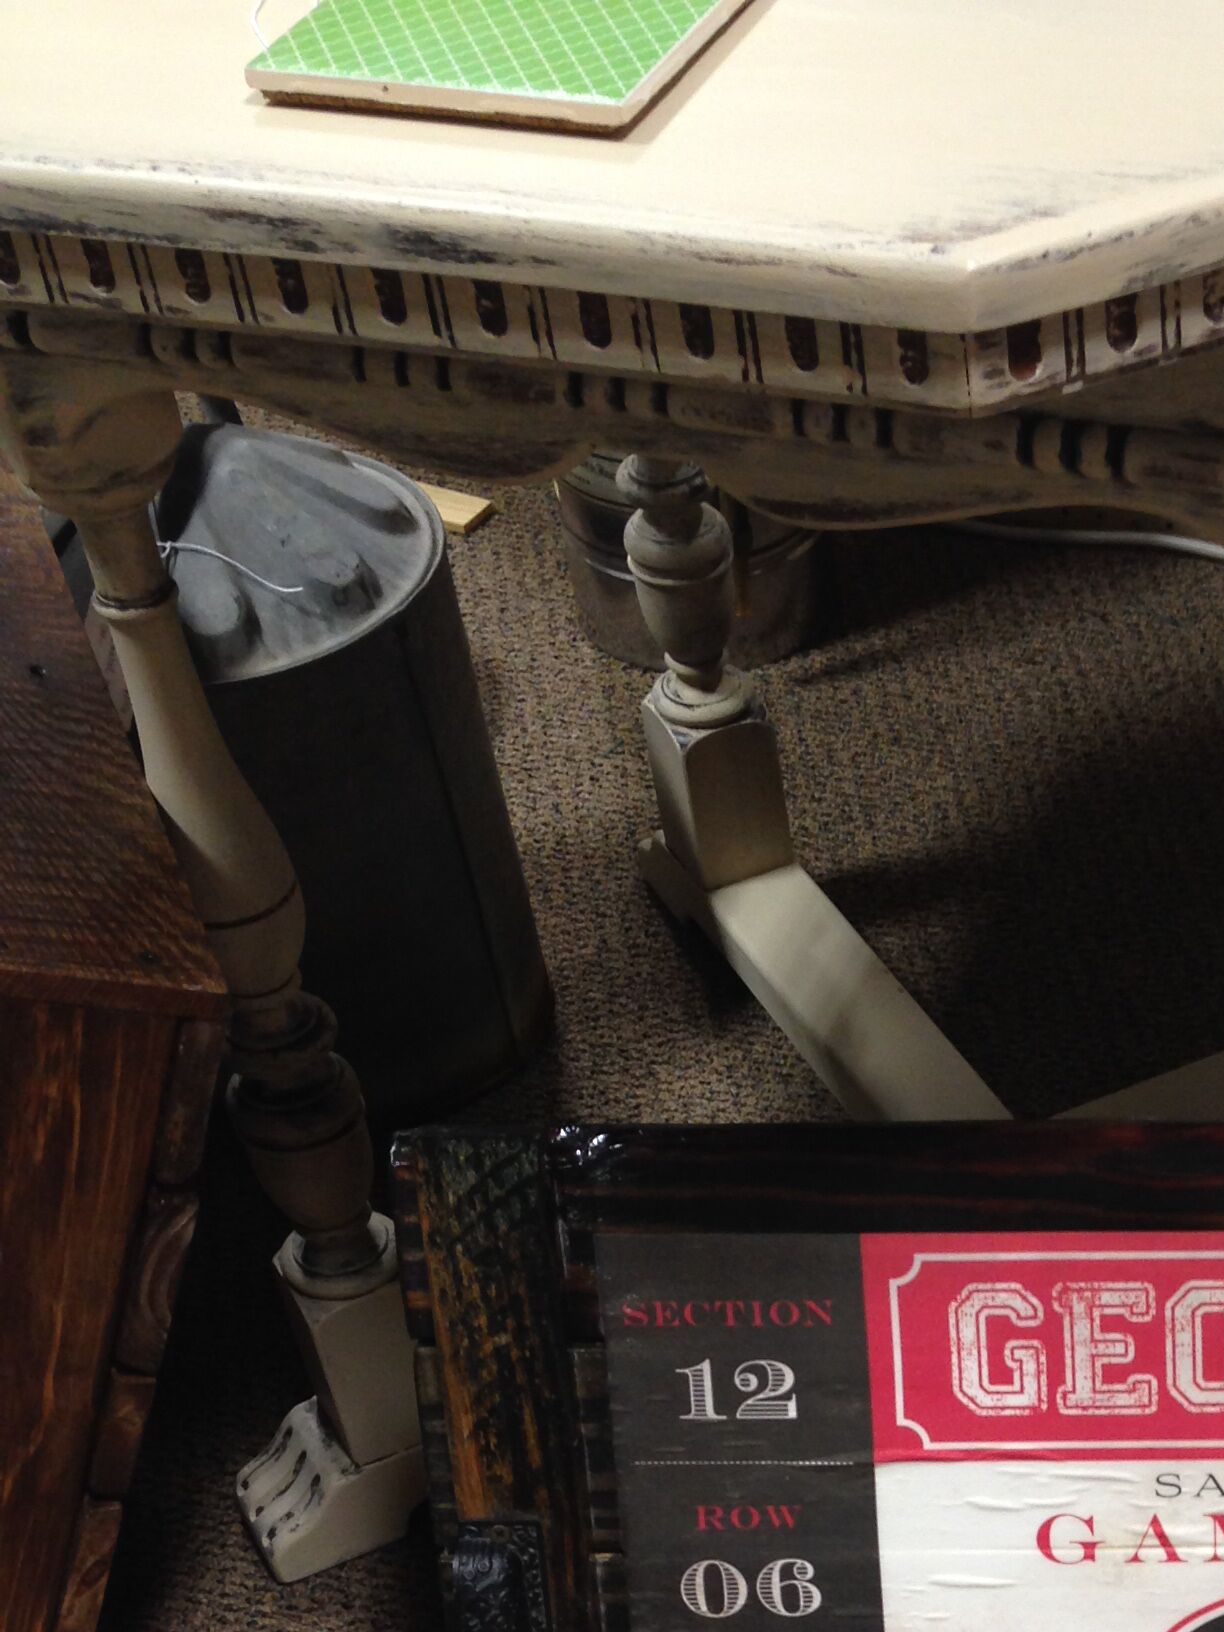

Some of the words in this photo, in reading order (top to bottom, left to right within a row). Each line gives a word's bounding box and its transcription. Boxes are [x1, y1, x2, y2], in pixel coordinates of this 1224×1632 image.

[622, 1300, 833, 1328] SECTION
[674, 1358, 799, 1422] 12
[695, 1503, 801, 1531] ROW
[679, 1558, 823, 1618] 06
